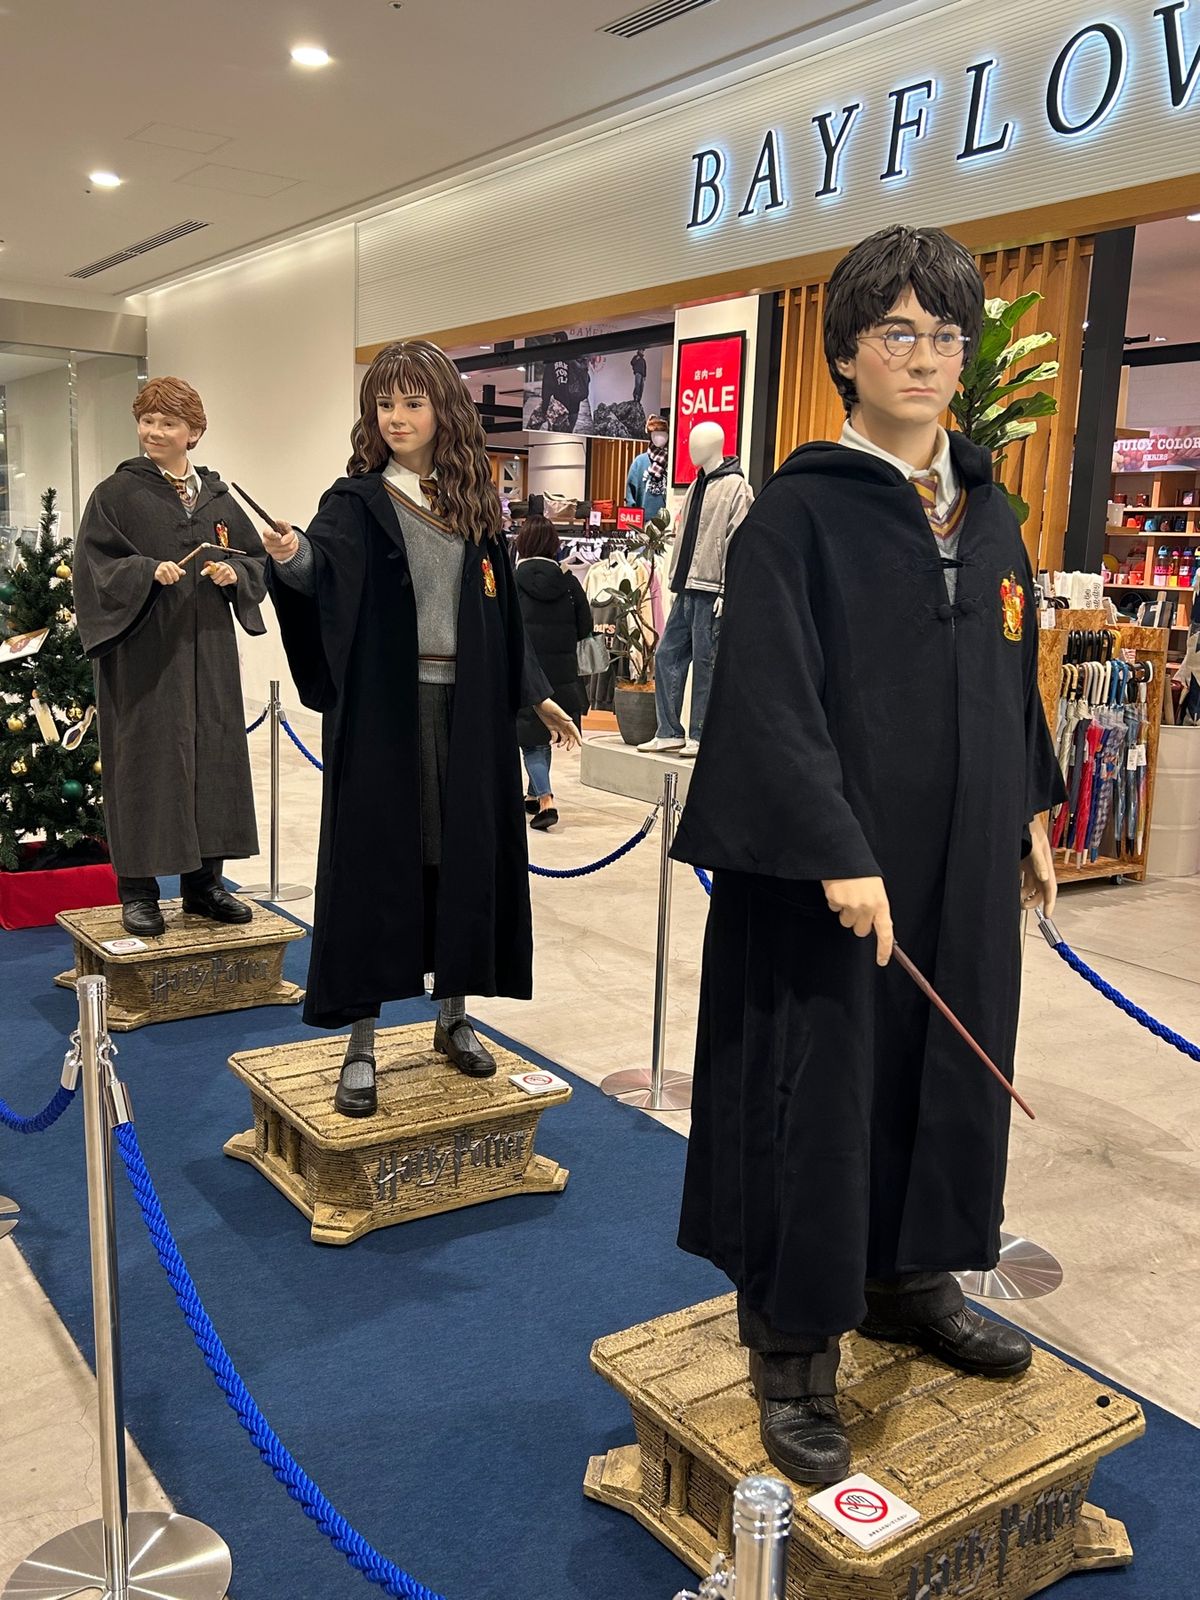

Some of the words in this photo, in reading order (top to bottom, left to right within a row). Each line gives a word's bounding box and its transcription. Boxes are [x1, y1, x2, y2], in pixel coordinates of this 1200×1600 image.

[694, 367, 723, 381] 店内一部
[681, 385, 735, 416] SALE
[1113, 438, 1156, 452] JUICY
[1143, 453, 1168, 462] SERIES
[620, 512, 641, 524] SALE
[150, 964, 208, 1002] Harry
[208, 957, 267, 996] Potter
[373, 1143, 450, 1200] Harry
[453, 1131, 525, 1188] Potter
[998, 1481, 1082, 1586] Potter
